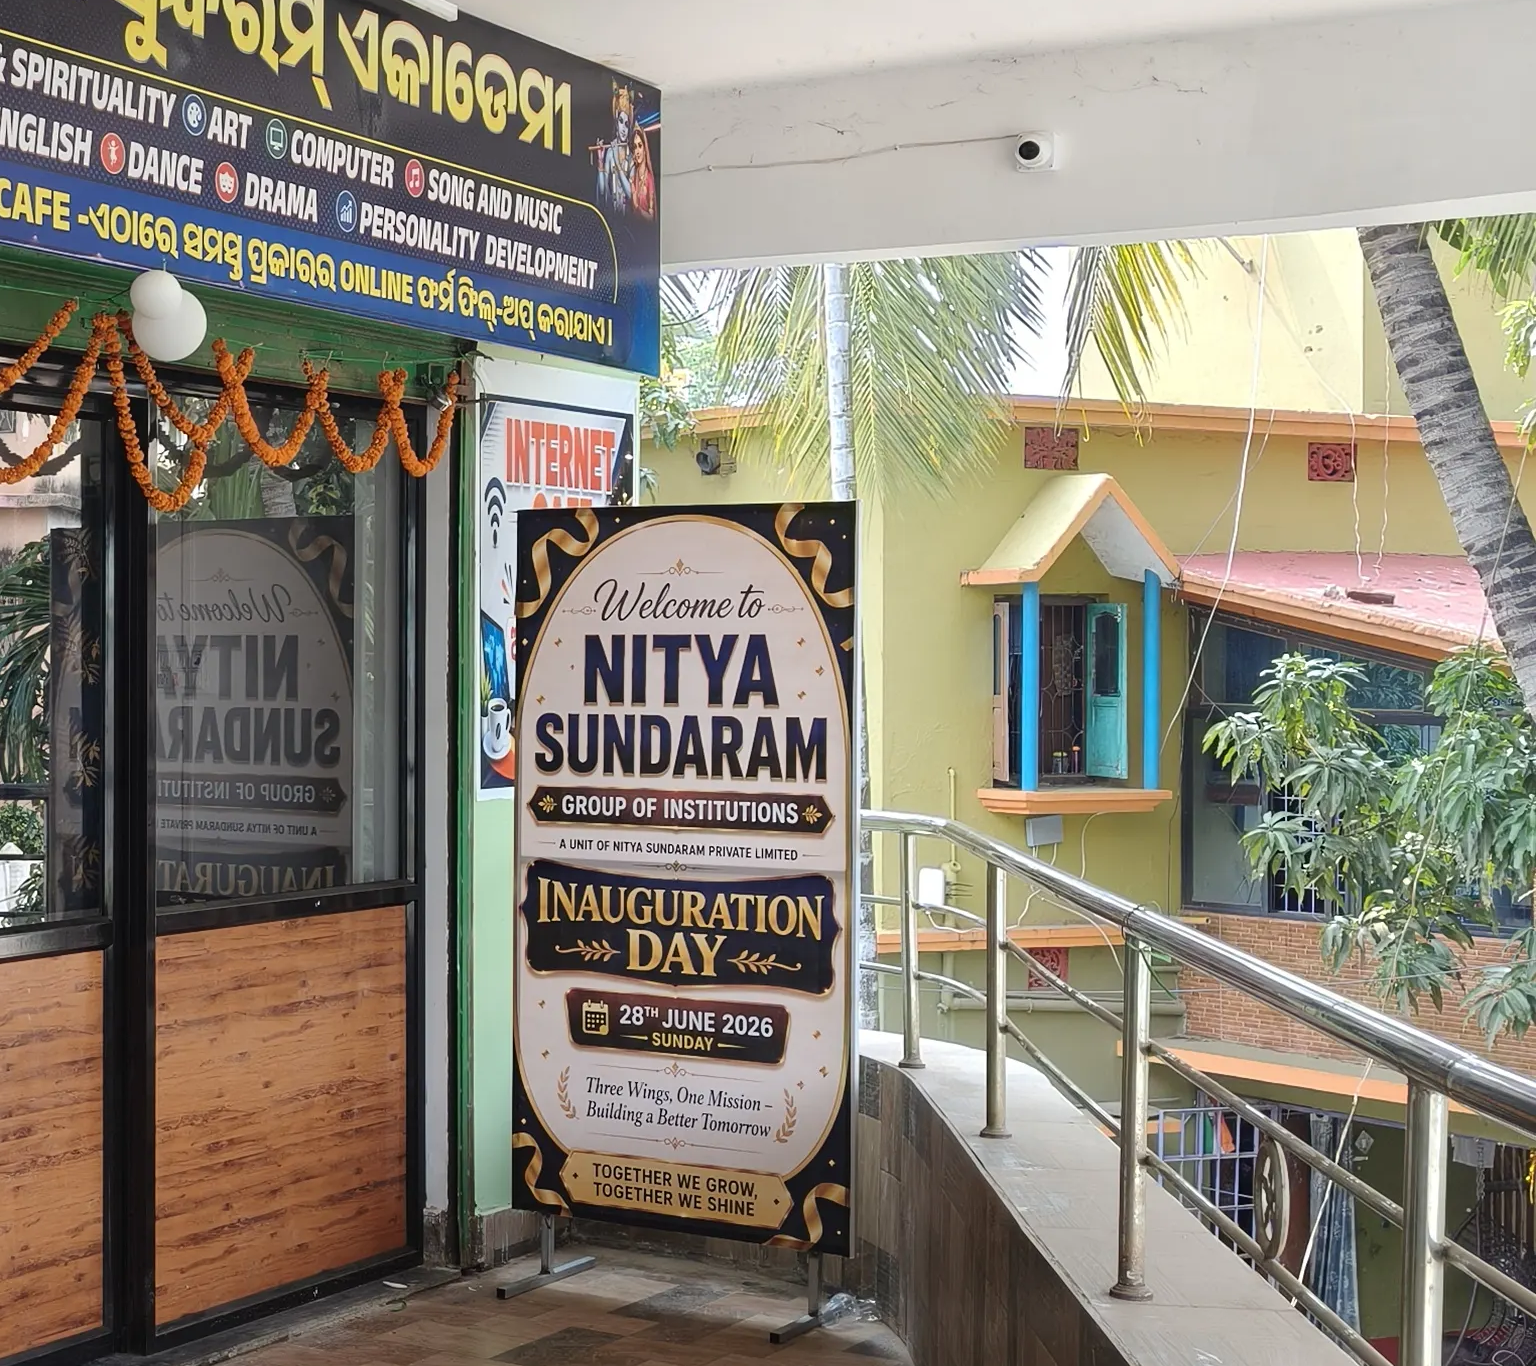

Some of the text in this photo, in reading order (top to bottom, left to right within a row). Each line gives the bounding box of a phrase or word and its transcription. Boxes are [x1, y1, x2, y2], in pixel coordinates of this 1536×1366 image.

[339, 9, 572, 156] ଏକାଡେମୀ
[11, 51, 176, 128] SPIRITUALITY
[208, 106, 253, 149] ART
[291, 129, 395, 189] COMPUTER
[428, 169, 474, 210] SONG
[477, 184, 511, 222] AND
[515, 193, 563, 235] MUSIC
[128, 143, 204, 195] DANCE
[244, 173, 318, 224] DRAMA
[360, 202, 480, 260] PERSONALITY
[485, 235, 598, 291] DEVELOPMENT
[340, 260, 414, 304] ONLINE
[505, 418, 615, 495] INTERNET
[594, 578, 765, 621] Welcome to
[584, 634, 779, 708] NITYA
[535, 712, 827, 783] SUNDARAM
[561, 794, 799, 825] GROUP OF INSTITUTIONS
[559, 838, 797, 861] A UNIT OF NITYA SUNDARAM PRIVATE LIMITED
[537, 876, 824, 940] INAUGURATION
[626, 929, 727, 977] DAY
[652, 1032, 714, 1052] SUNDAY
[662, 1009, 715, 1032] JUNE
[722, 1015, 773, 1038] 2026
[586, 1076, 761, 1111] Three Wings, One Mission
[586, 1102, 771, 1138] Building a Better Tomorrow
[593, 1163, 758, 1201] TOGETHER WE GROW,
[594, 1182, 755, 1217] TOGETHER WE SHINE
